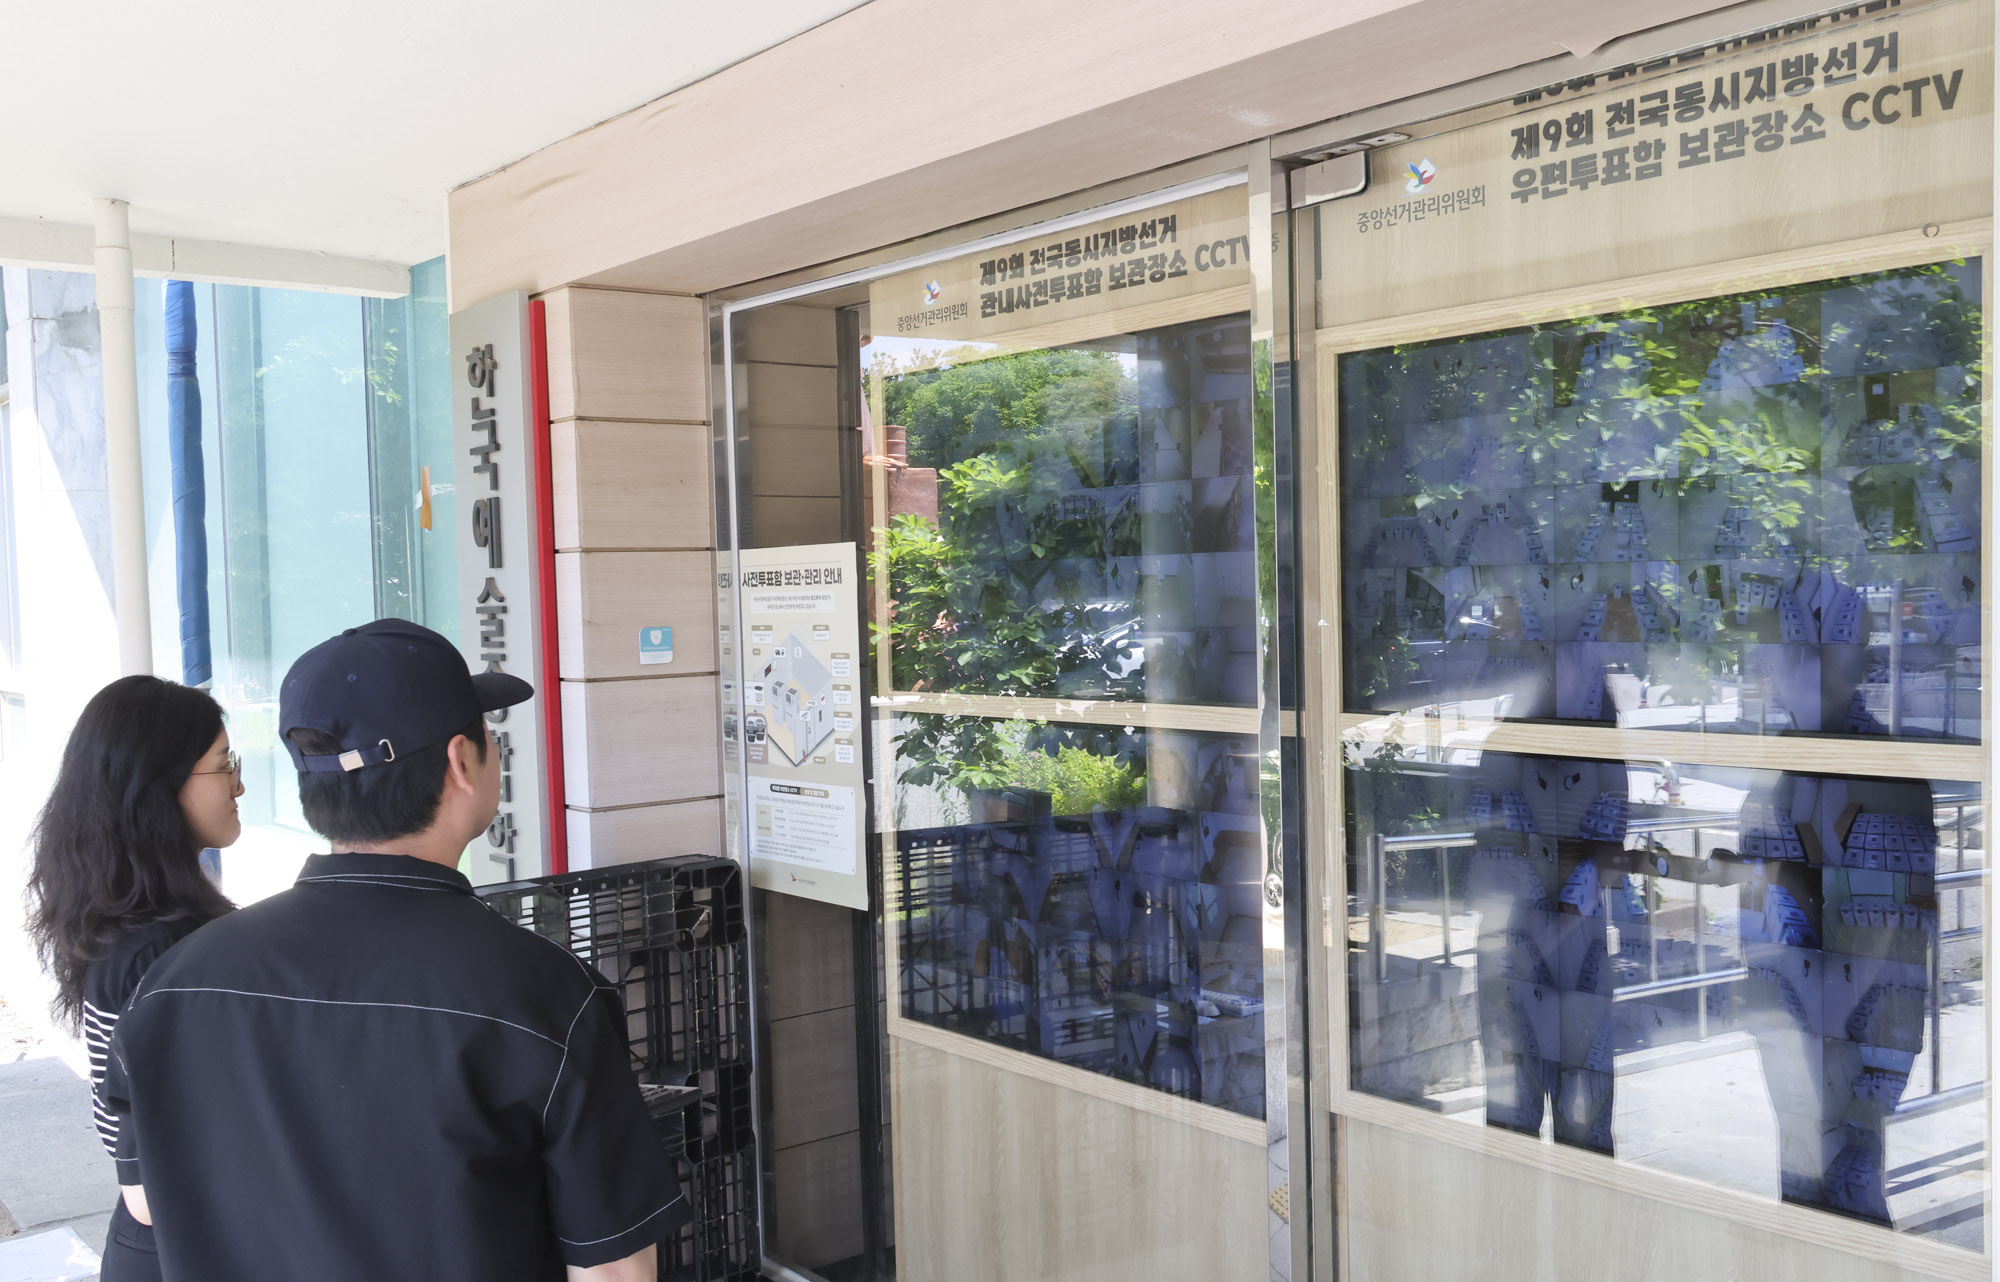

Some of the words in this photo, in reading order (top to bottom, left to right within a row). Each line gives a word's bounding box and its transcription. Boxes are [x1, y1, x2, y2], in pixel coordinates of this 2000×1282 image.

[1511, 109, 1594, 160] 제9회
[1606, 31, 1899, 140] 전국동시지방선거
[1511, 138, 1666, 204] 우편투표함
[1678, 103, 1826, 169] 보관장소
[1842, 69, 1964, 131] CCTV
[1357, 184, 1486, 233] 중앙선거관리위원회
[980, 252, 1025, 286] 제9회
[1029, 214, 1177, 276] 전국동시지방선거
[980, 267, 1103, 318] 관내사전투표함
[1108, 249, 1188, 291] 보관장소
[897, 301, 968, 333] 중앙선거관리위원회
[742, 570, 783, 588] 사전투표함
[784, 568, 822, 586] 보관·관리
[823, 567, 843, 585] 안내
